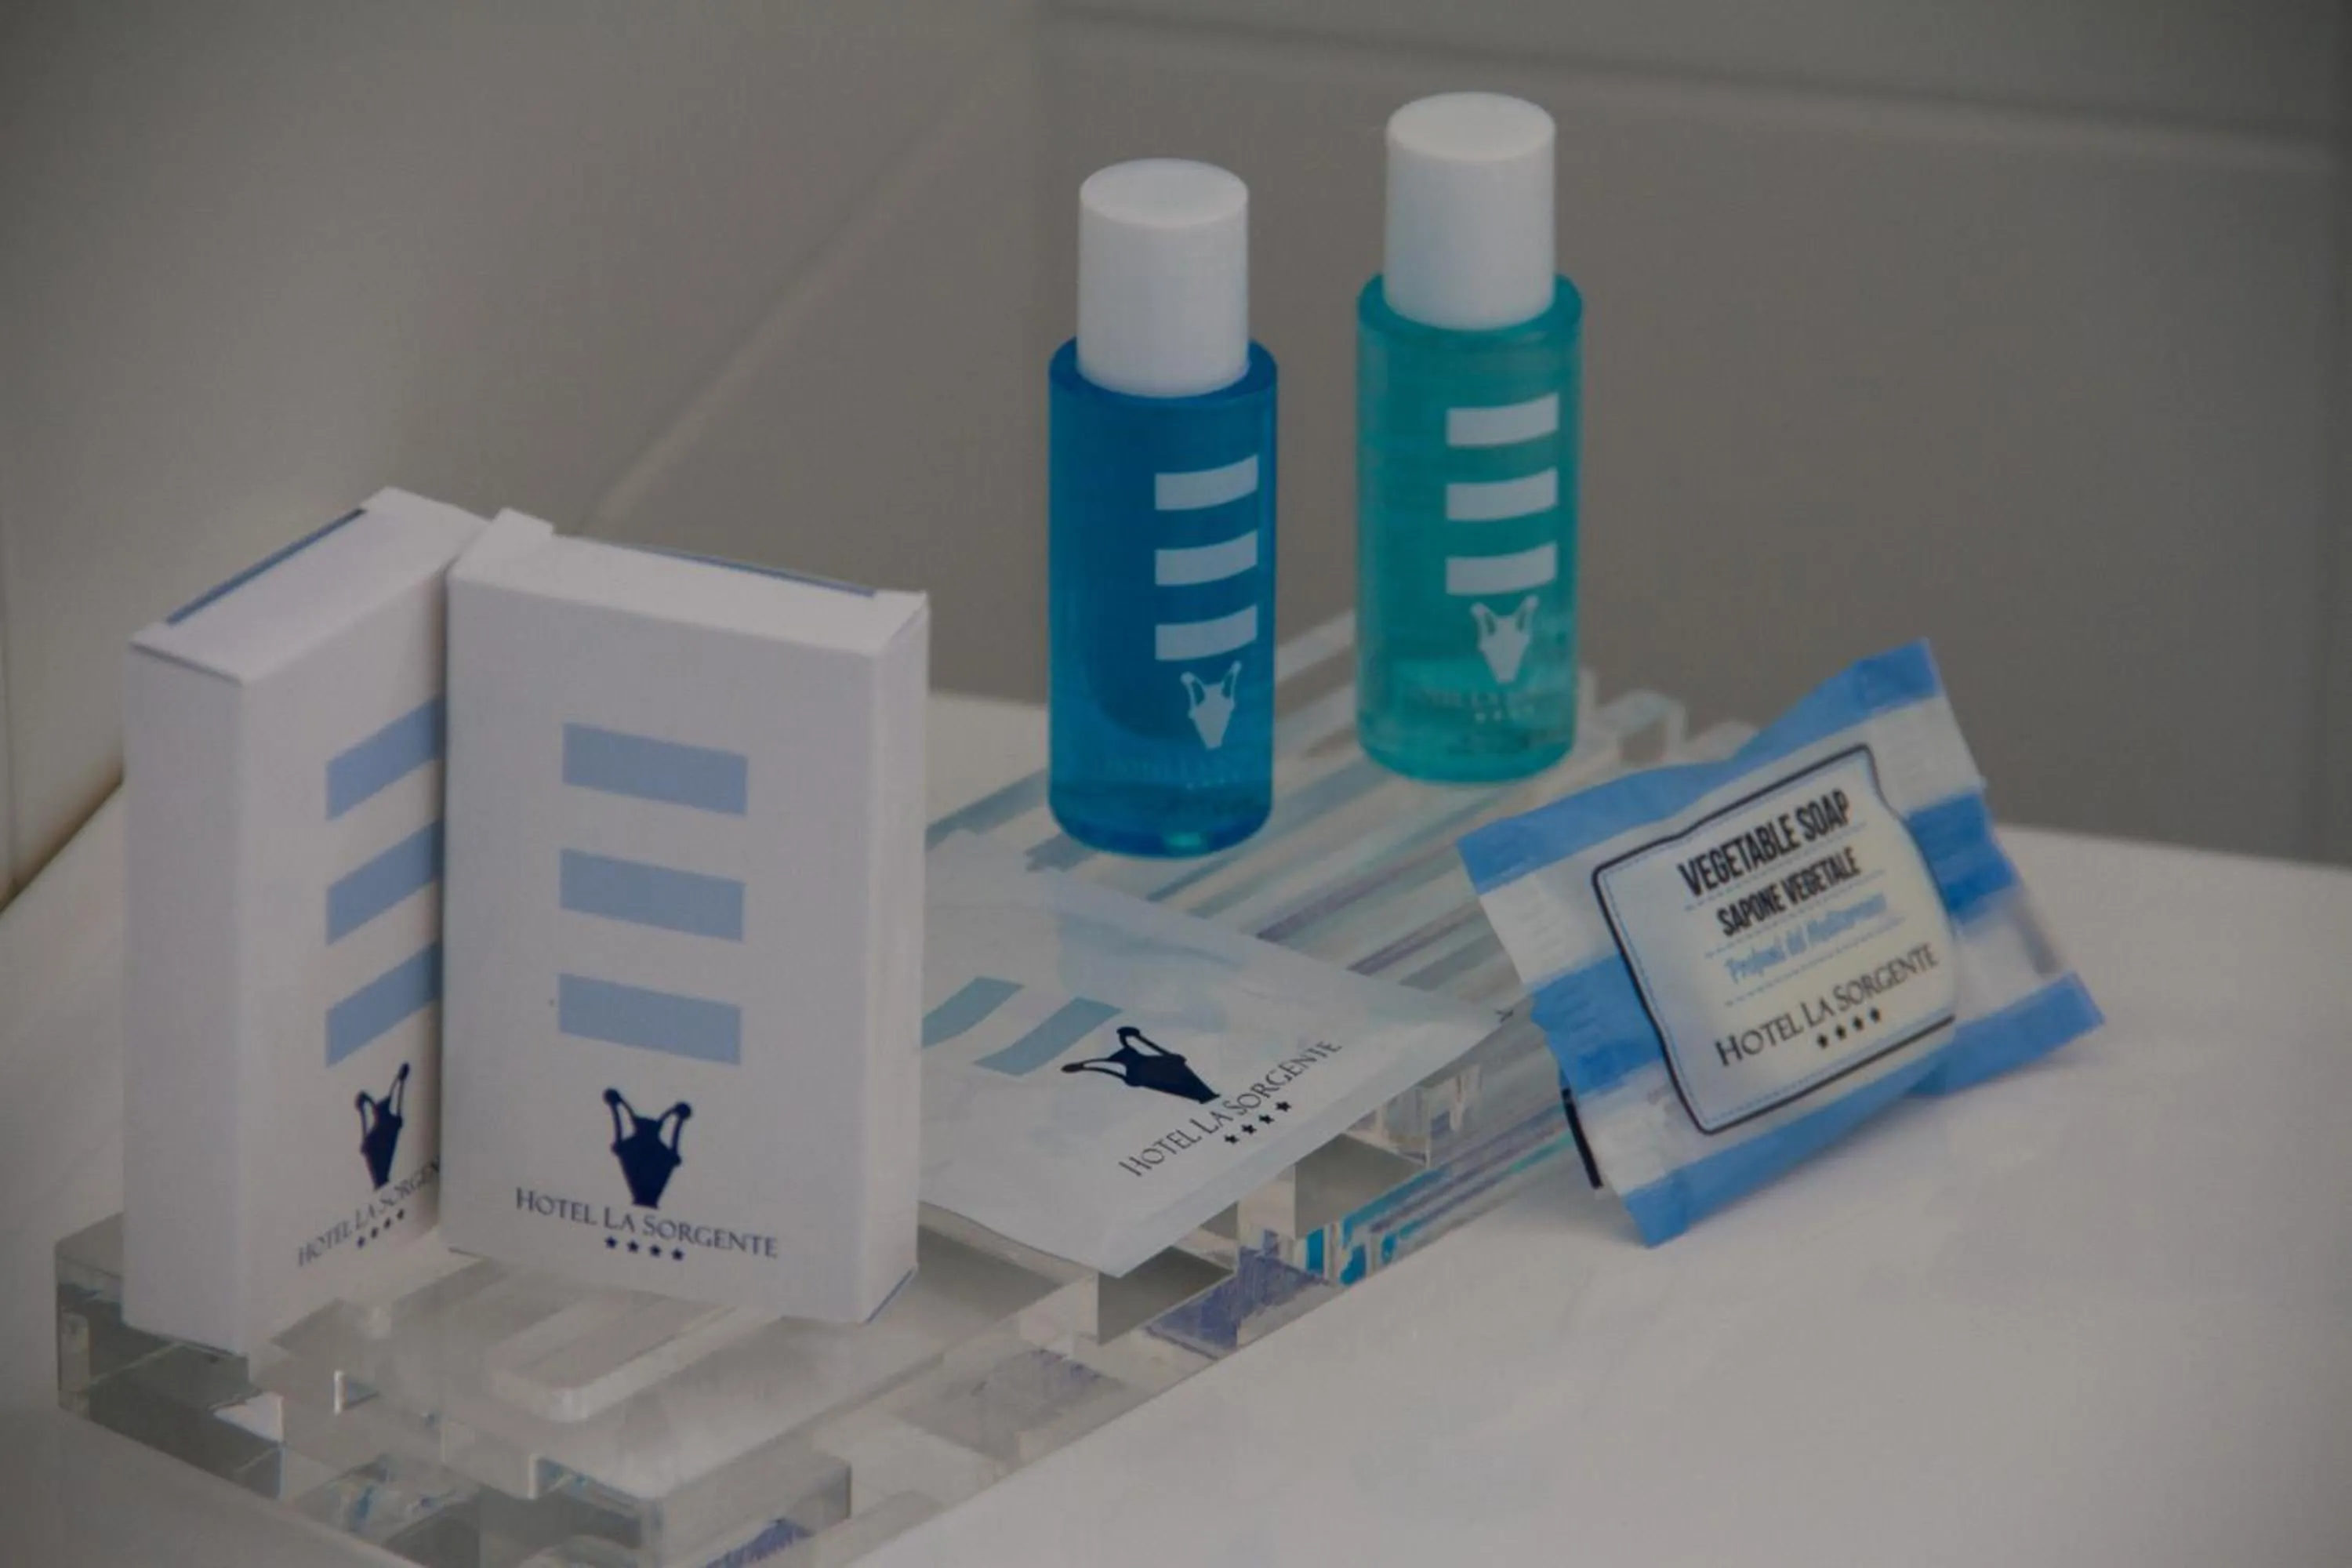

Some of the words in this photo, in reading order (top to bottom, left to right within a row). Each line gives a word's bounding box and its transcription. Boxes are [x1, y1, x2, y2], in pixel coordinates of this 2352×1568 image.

[1677, 813, 1801, 897] VEGETABLE
[1795, 788, 1850, 841] SOAP
[1717, 884, 1786, 937] SAPONE
[1781, 846, 1862, 906] VEGETALE
[1714, 1011, 1803, 1067] HOTEL
[1800, 1001, 1834, 1029] LA
[1833, 943, 1940, 1014] SORGENTE
[1118, 1128, 1203, 1177] HOTEL
[1189, 1111, 1233, 1135] LA
[1221, 1040, 1343, 1116] SORGENTE
[516, 1186, 597, 1225] HOTEL
[604, 1207, 636, 1233] LA
[641, 1214, 779, 1259] SORGENTE
